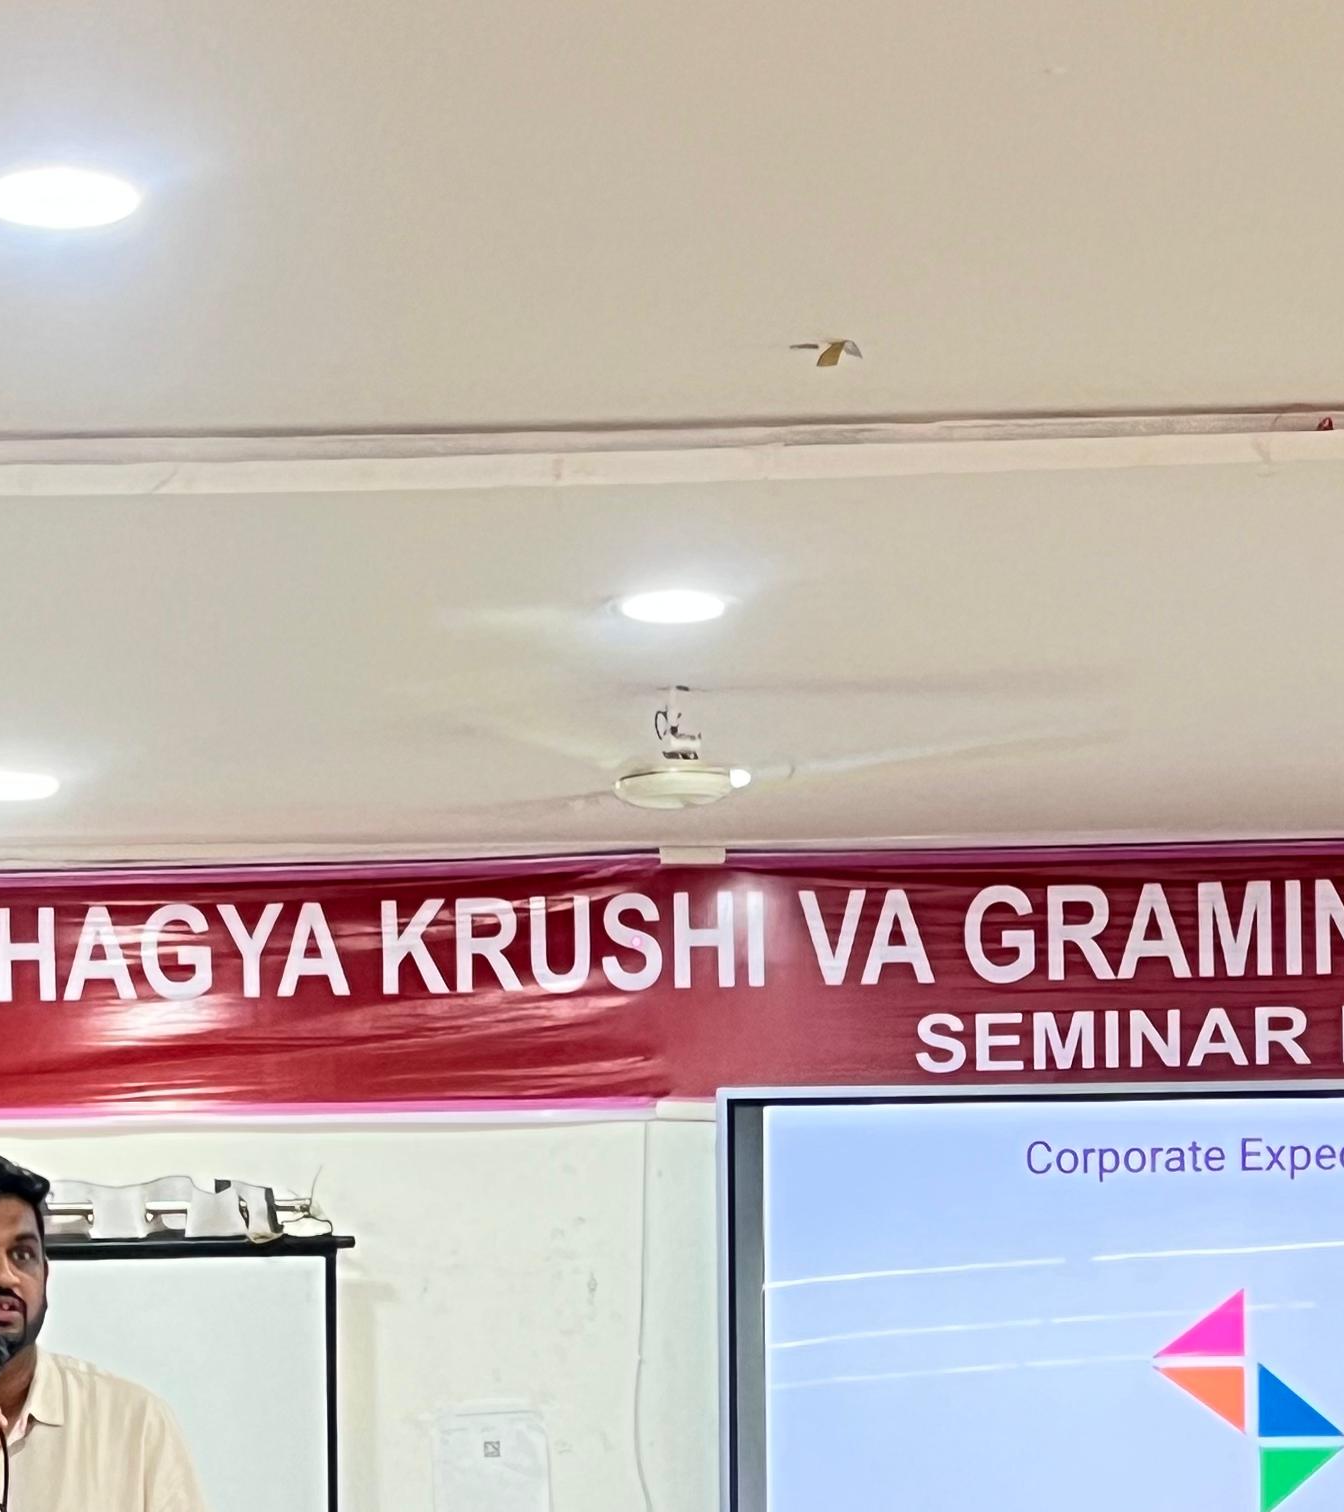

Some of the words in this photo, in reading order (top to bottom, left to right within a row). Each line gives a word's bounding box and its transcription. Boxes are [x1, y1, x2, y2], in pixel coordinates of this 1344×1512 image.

[380, 888, 766, 995] KRUSHI
[798, 888, 935, 986] VA
[914, 1005, 1311, 1073] SEMINAR
[1025, 1139, 1226, 1183] Corporate
